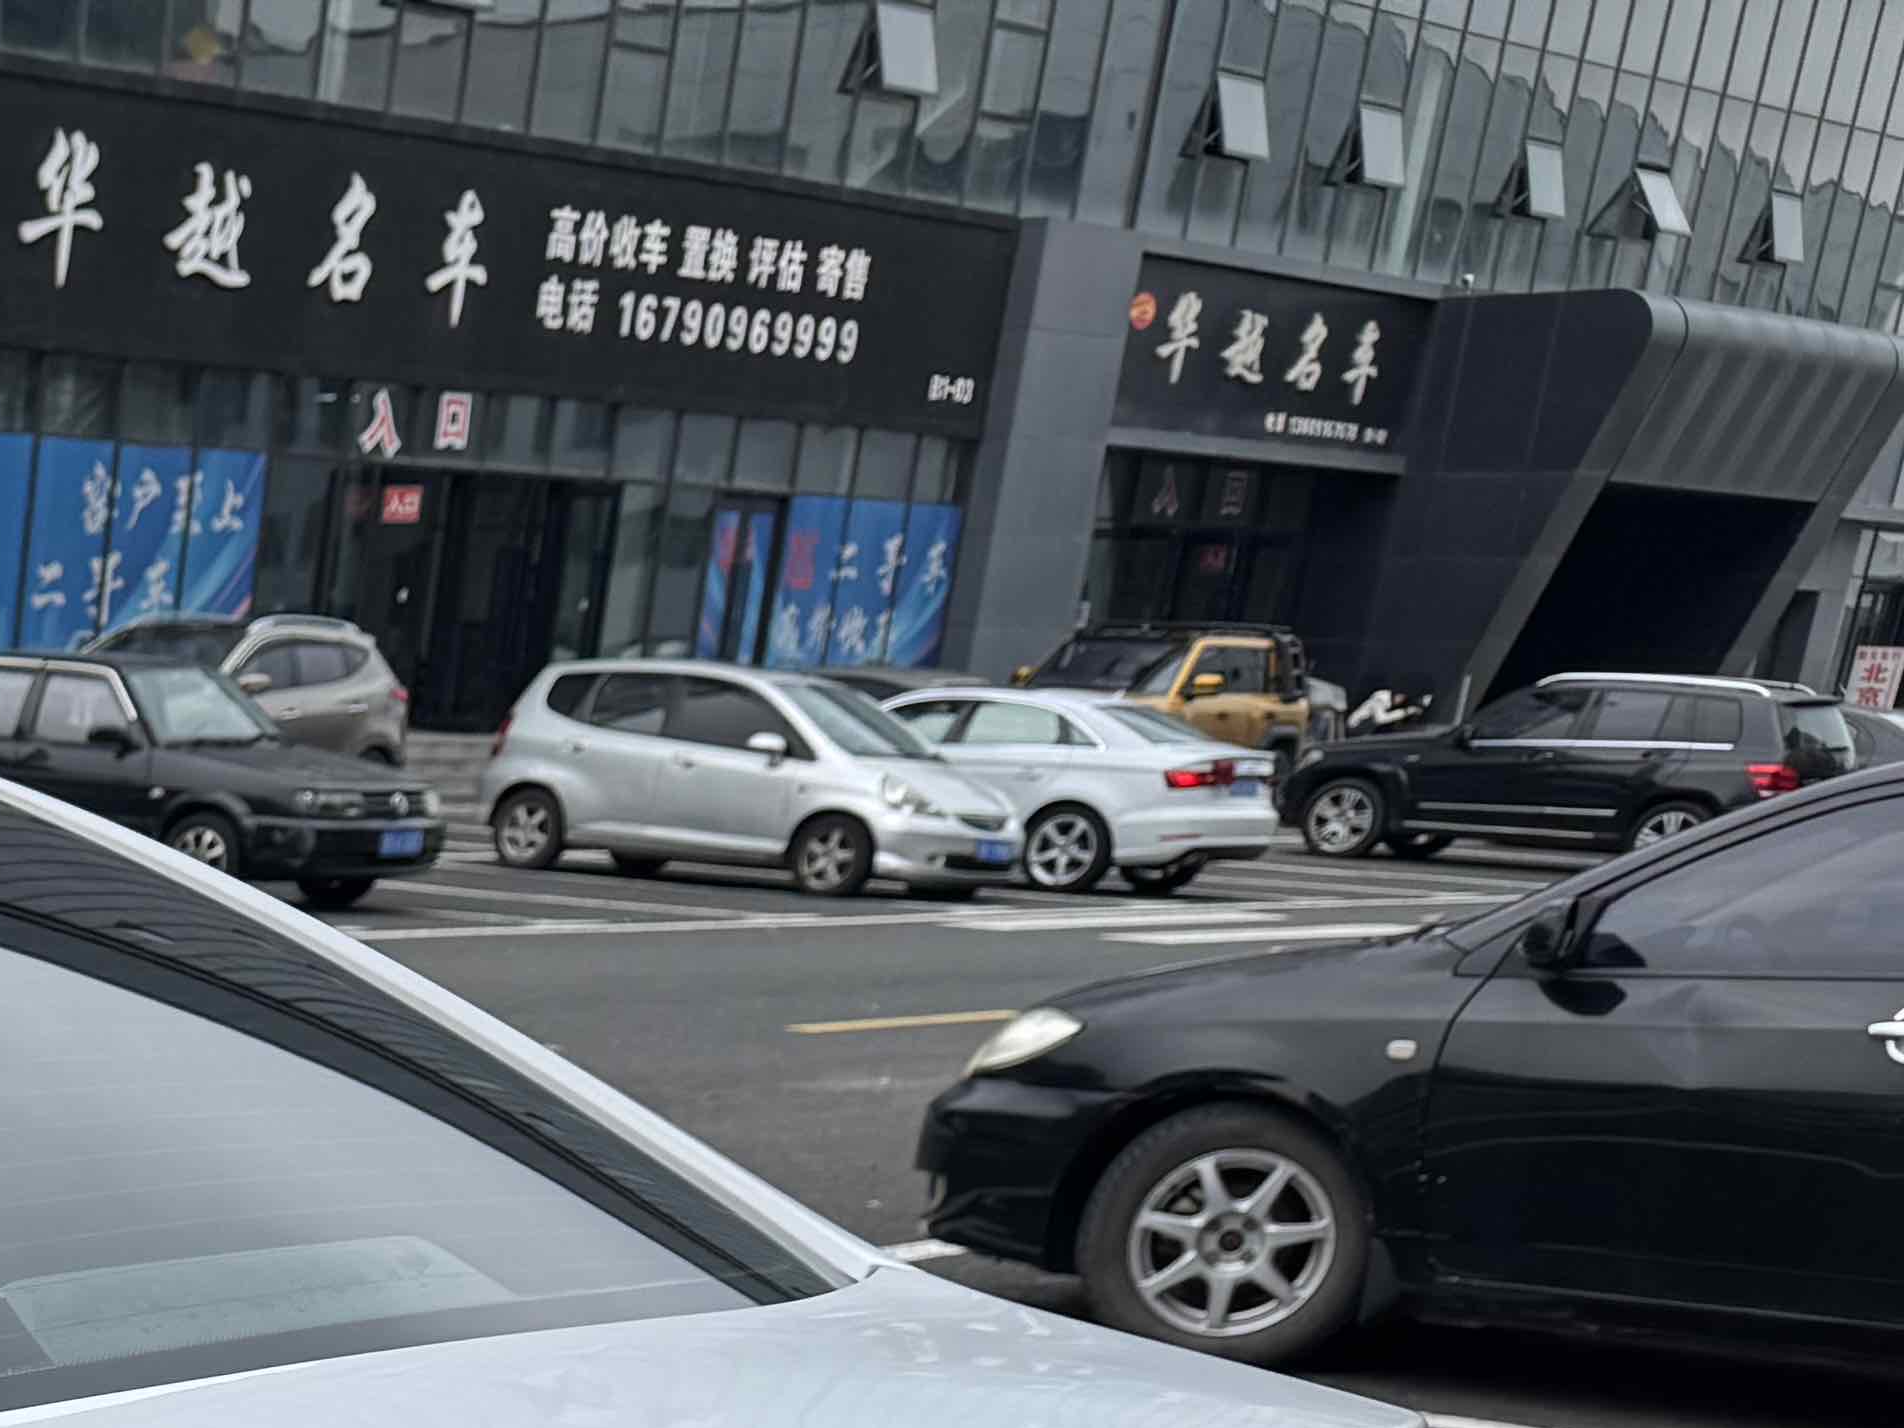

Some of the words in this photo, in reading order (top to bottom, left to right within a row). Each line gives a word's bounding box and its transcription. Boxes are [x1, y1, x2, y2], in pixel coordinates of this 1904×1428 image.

[17, 126, 489, 329] 华越名车
[545, 204, 672, 274] 高价收车
[677, 225, 740, 283] 置换
[747, 236, 809, 293] 评估
[815, 244, 872, 301] 寄售
[535, 274, 600, 334] 电话
[618, 290, 860, 365] 16790969999
[1154, 291, 1381, 406] 华越名车
[358, 387, 473, 459] 入口
